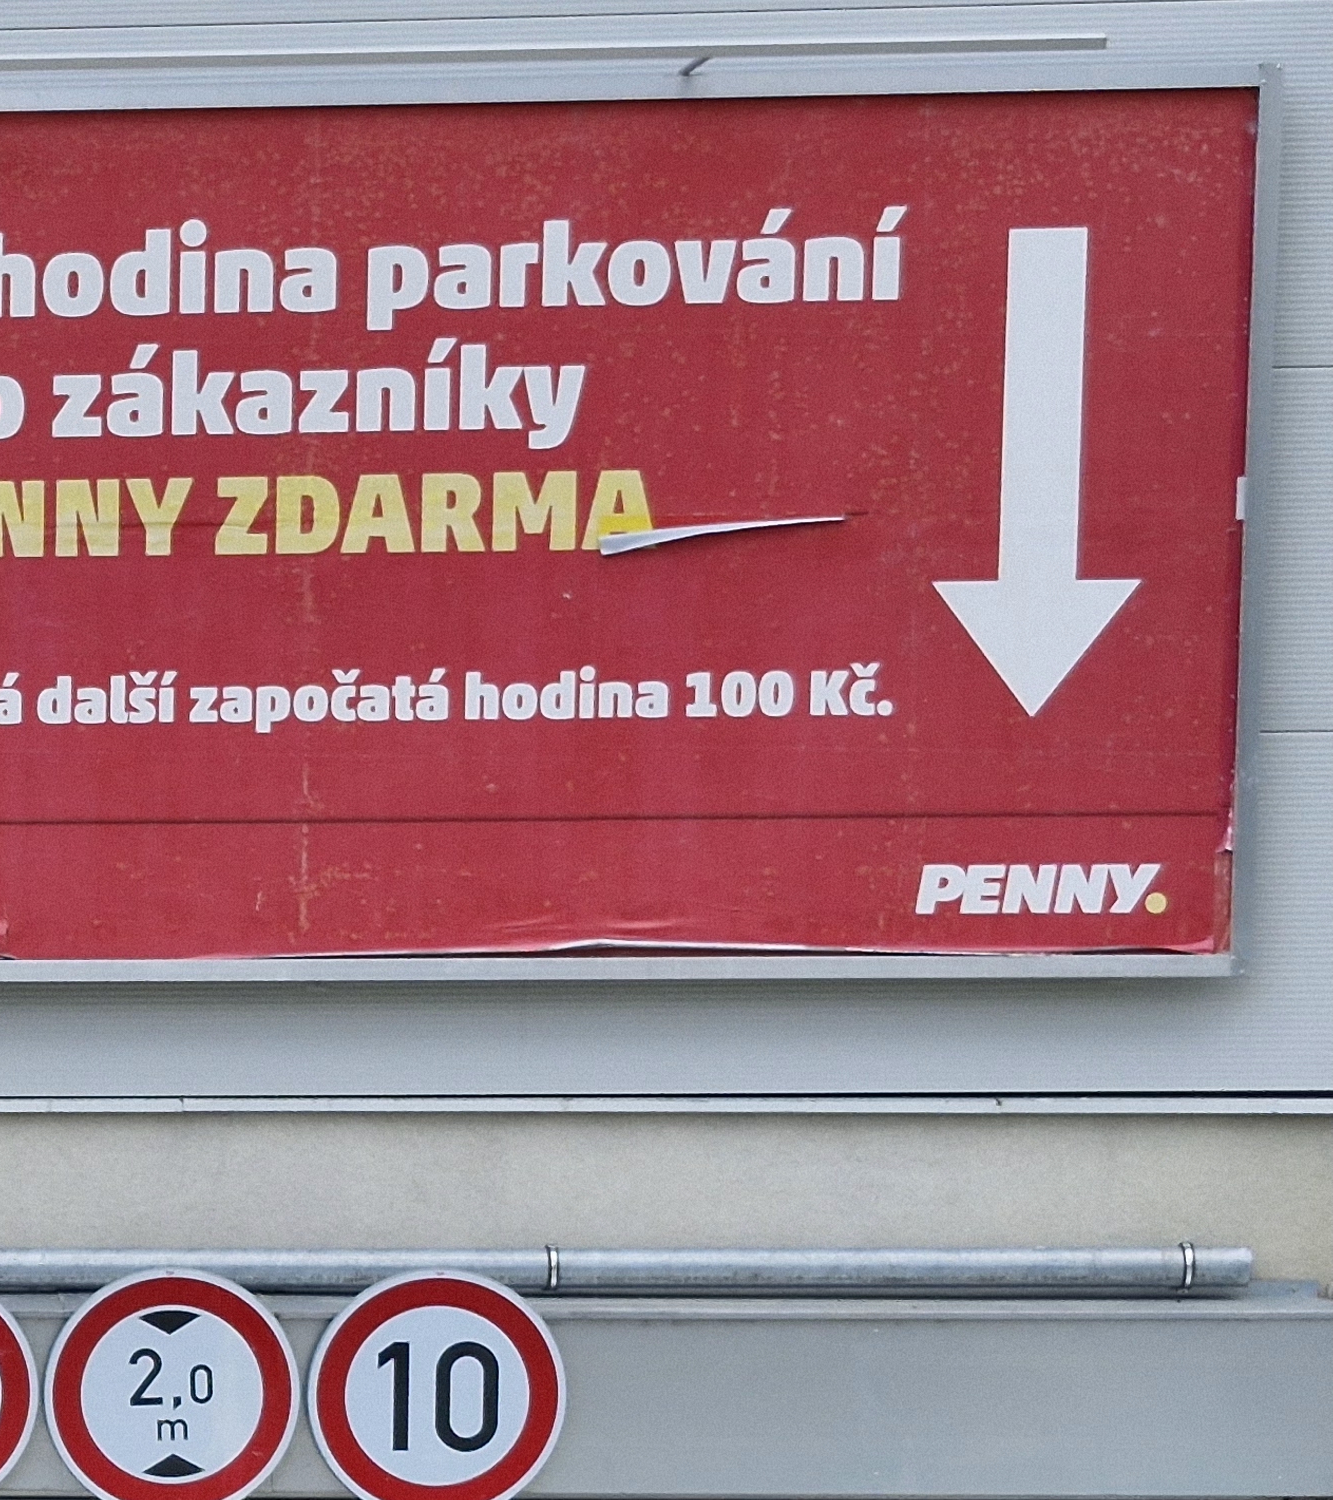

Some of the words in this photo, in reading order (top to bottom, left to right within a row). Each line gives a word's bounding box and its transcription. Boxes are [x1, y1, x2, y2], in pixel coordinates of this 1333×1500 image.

[366, 206, 908, 331] parkování
[52, 337, 585, 449] zákazníky
[214, 469, 657, 556] ZDARMA
[37, 671, 177, 727] další
[189, 668, 449, 733] započatá
[465, 665, 669, 720] hodina
[685, 671, 795, 718] 100
[810, 662, 894, 718] Kč.
[914, 863, 1167, 915] PENNY.
[129, 1347, 214, 1411] 2,0
[376, 1340, 500, 1453] 10
[156, 1414, 190, 1443] m
